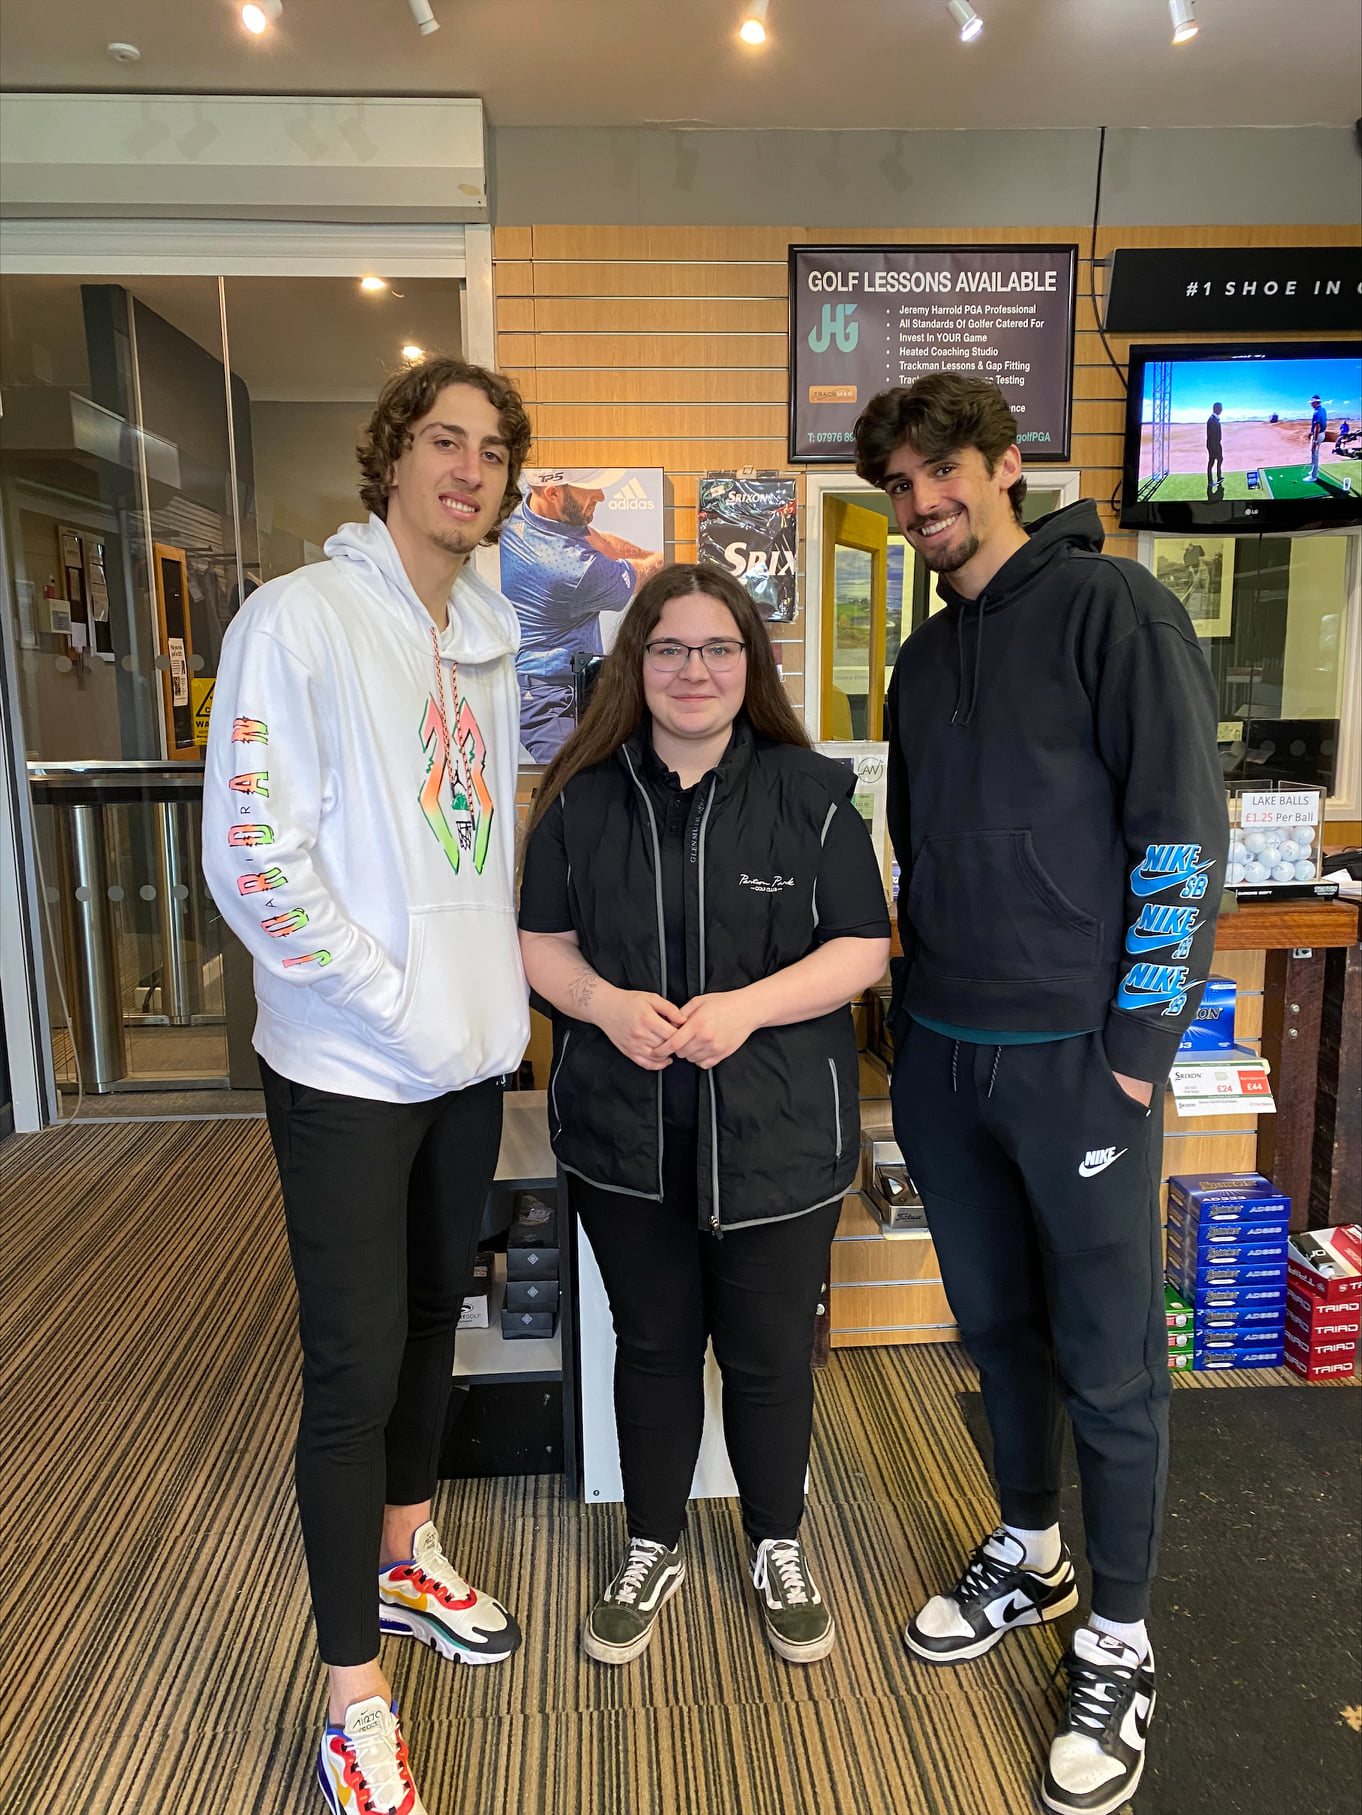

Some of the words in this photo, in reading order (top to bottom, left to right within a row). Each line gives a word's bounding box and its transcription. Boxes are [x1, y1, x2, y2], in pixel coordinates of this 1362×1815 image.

[808, 271, 859, 292] GOLF
[864, 271, 951, 293] LESSONS
[955, 271, 1057, 292] AVAILABLE
[1186, 281, 1211, 296] #1
[1225, 281, 1297, 295] SHOE
[1314, 280, 1341, 295] IN
[899, 305, 930, 316] Jeremy
[932, 305, 962, 315] Harrold
[964, 305, 983, 315] PGA
[985, 304, 1036, 314] Professional
[899, 319, 911, 328] All
[913, 319, 953, 329] Standards
[956, 319, 966, 328] Of
[968, 319, 994, 328] Golfer
[996, 318, 1028, 328] Catered
[1031, 318, 1044, 328] For
[899, 333, 925, 342] Invest
[927, 333, 934, 342] In
[937, 333, 961, 342] YOUR
[963, 333, 988, 342] Game
[899, 347, 929, 356] Heated
[931, 347, 970, 358] Coaching
[972, 347, 999, 356] Studio
[899, 361, 939, 370] Trackman
[942, 361, 975, 370] Lessons
[978, 361, 984, 370] &
[986, 361, 1001, 372] Gap
[1005, 361, 1031, 371] Fitting
[996, 375, 1025, 386] Testing
[1016, 432, 1051, 444] golfPGA
[608, 498, 655, 510] adidas
[1252, 796, 1277, 805] LAKE
[1279, 796, 1309, 805] BALLS
[1246, 813, 1273, 822] £1.25
[1276, 813, 1293, 822] Per
[1295, 812, 1313, 822] Ball
[1142, 844, 1201, 872] NIKE
[1180, 874, 1208, 899] SB
[1139, 903, 1200, 933] NIKE
[1126, 963, 1189, 993] NIKE
[1175, 1072, 1202, 1081] SRIXON
[1084, 1146, 1116, 1166] NIKE
[1316, 1303, 1360, 1313] TRIAD
[1314, 1324, 1358, 1335] TRIAD
[1315, 1342, 1355, 1354] TRIAD
[1312, 1362, 1352, 1374] TRIAD
